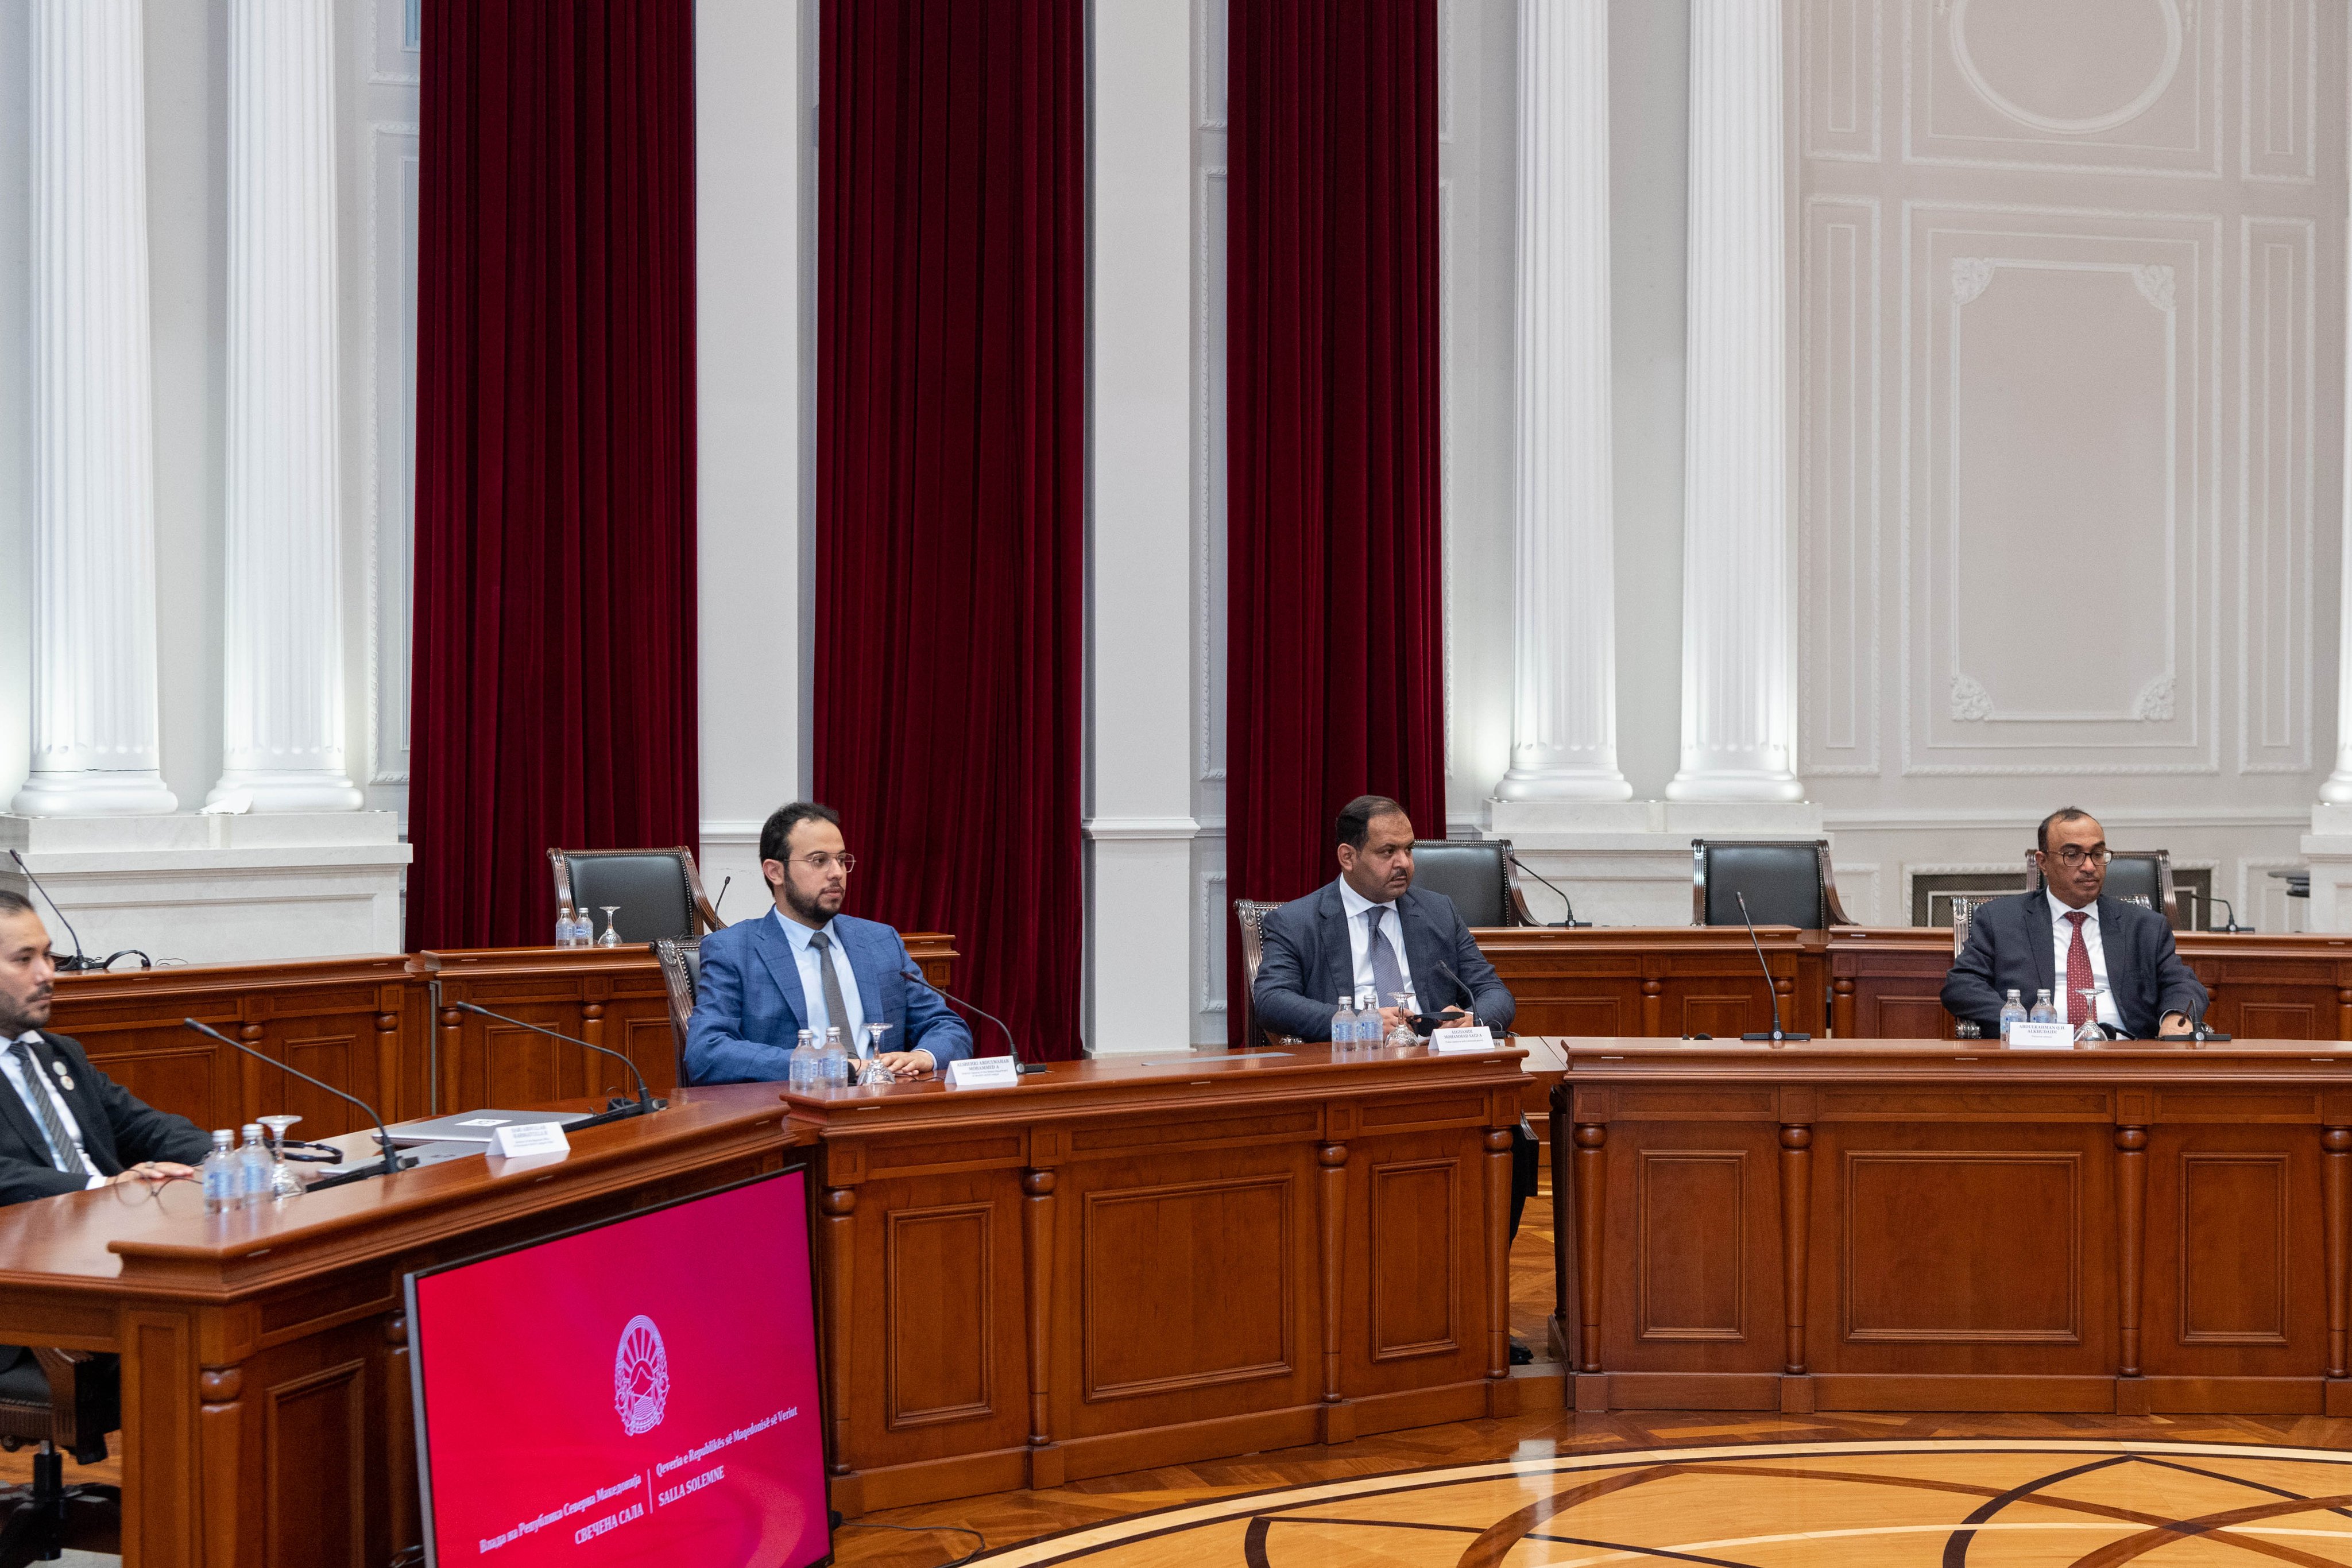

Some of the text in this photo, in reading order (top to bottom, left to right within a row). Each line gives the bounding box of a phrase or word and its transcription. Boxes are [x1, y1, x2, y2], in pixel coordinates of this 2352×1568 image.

[656, 1407, 798, 1477] Qeveria e Republikës së Maqedonisë së Veriut
[479, 1473, 641, 1554] Влада на Република Северна Македонија
[658, 1465, 725, 1507] SALLA SOLEMNE
[575, 1503, 644, 1544] СВЕЧЕНА САЛА
